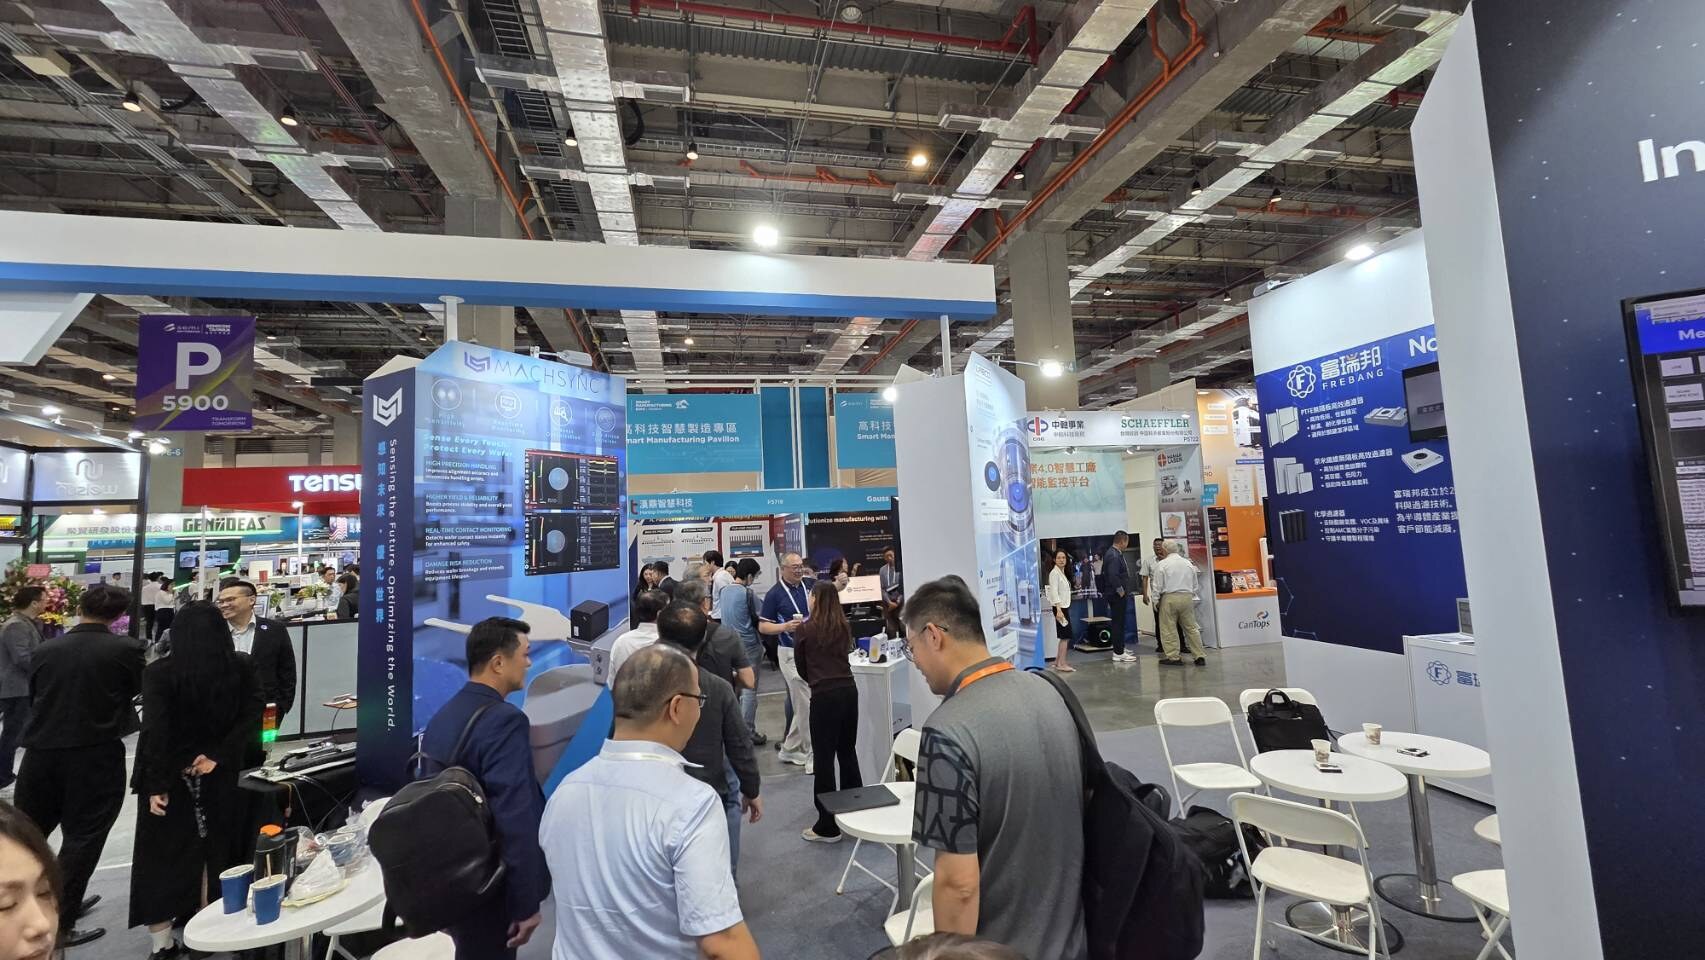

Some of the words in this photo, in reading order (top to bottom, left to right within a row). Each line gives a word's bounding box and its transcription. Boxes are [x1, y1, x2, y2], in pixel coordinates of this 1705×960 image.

[176, 342, 222, 389] P
[1320, 346, 1382, 381] 富瑞邦
[494, 359, 600, 394] MACHSYNC
[1322, 368, 1384, 390] FREBANG
[162, 395, 229, 411] 5900
[1121, 418, 1190, 428] SCHAEFFLER
[454, 436, 479, 446] Every
[646, 436, 706, 445] Manufacturing
[707, 435, 740, 443] Pavilion
[461, 447, 486, 456] Every
[388, 439, 397, 492] Sensing
[388, 496, 397, 518] the
[833, 515, 875, 523] manufacturing
[386, 575, 396, 652] Optimizing
[1238, 620, 1271, 630] CanTops
[387, 656, 396, 680] the
